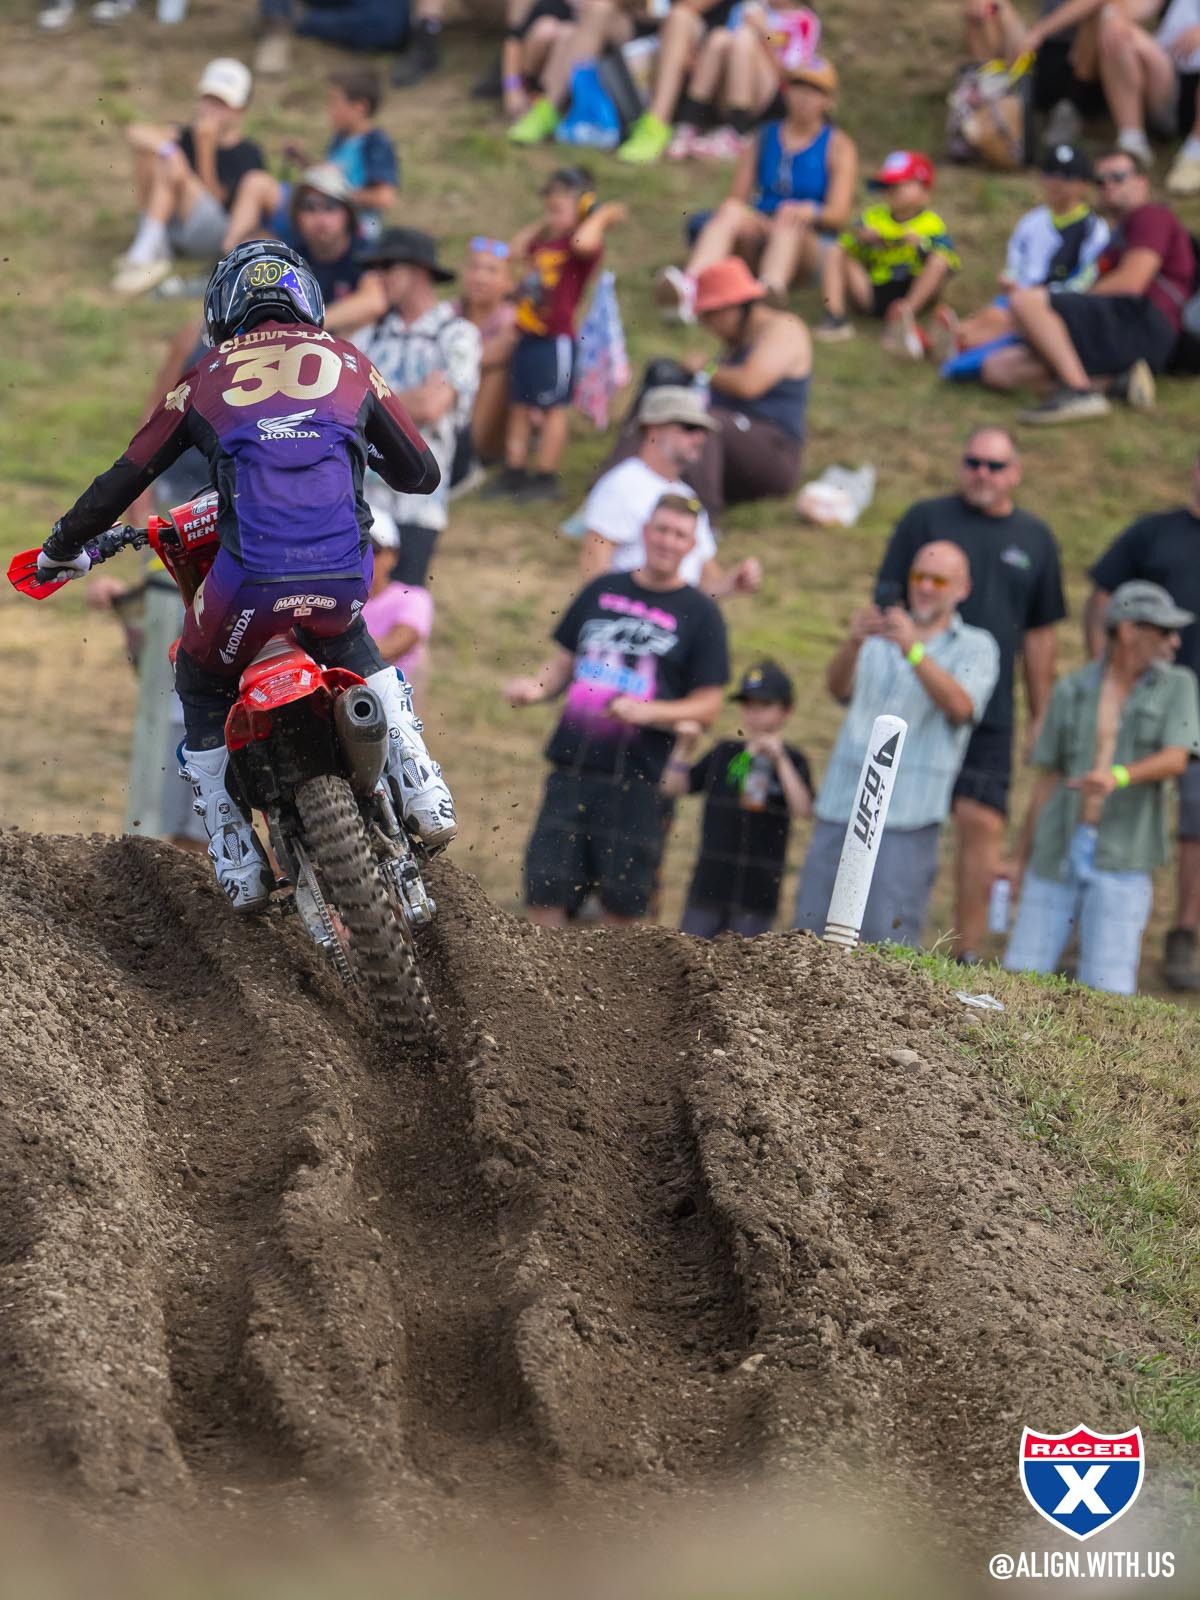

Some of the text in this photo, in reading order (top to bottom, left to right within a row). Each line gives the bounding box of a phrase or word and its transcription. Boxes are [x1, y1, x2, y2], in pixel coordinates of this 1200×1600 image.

[221, 342, 342, 407] 30
[260, 431, 320, 440] HONDA
[187, 524, 216, 541] REN
[275, 596, 336, 610] MAN CARD
[225, 608, 256, 655] HONDA
[853, 764, 881, 845] UFO
